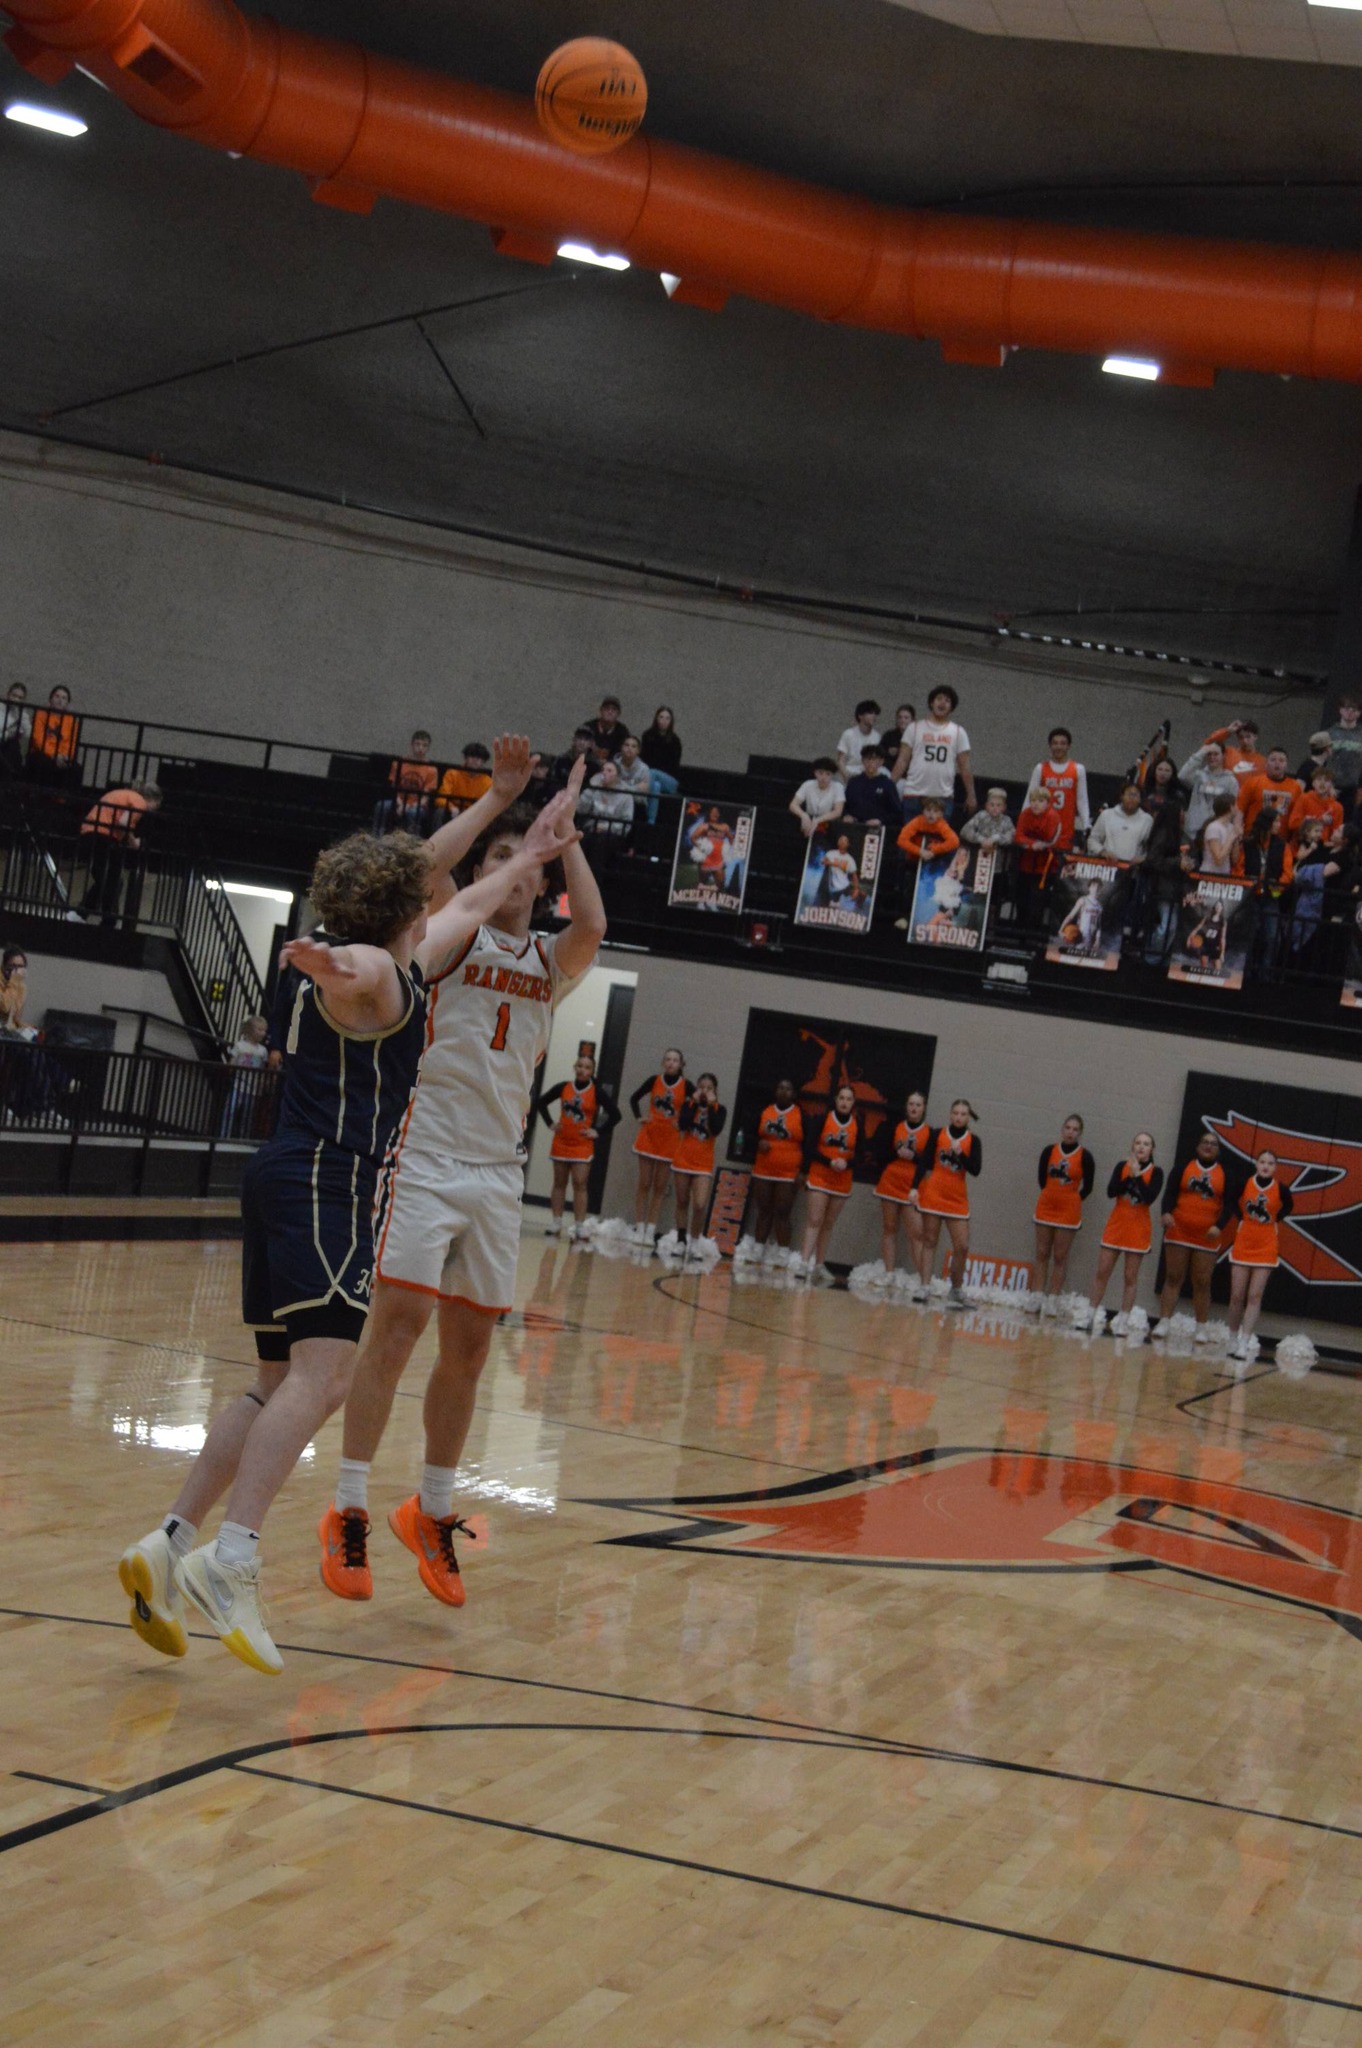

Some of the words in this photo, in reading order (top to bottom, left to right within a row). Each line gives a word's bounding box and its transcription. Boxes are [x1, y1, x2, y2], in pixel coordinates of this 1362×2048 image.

[924, 744, 948, 763] 50
[1075, 861, 1118, 882] KNIGHT
[1198, 880, 1244, 902] CARVER
[800, 905, 867, 931] JOHNSON
[915, 923, 979, 949] STRONG
[463, 964, 552, 1003] RANGERS
[490, 1001, 511, 1052] 1
